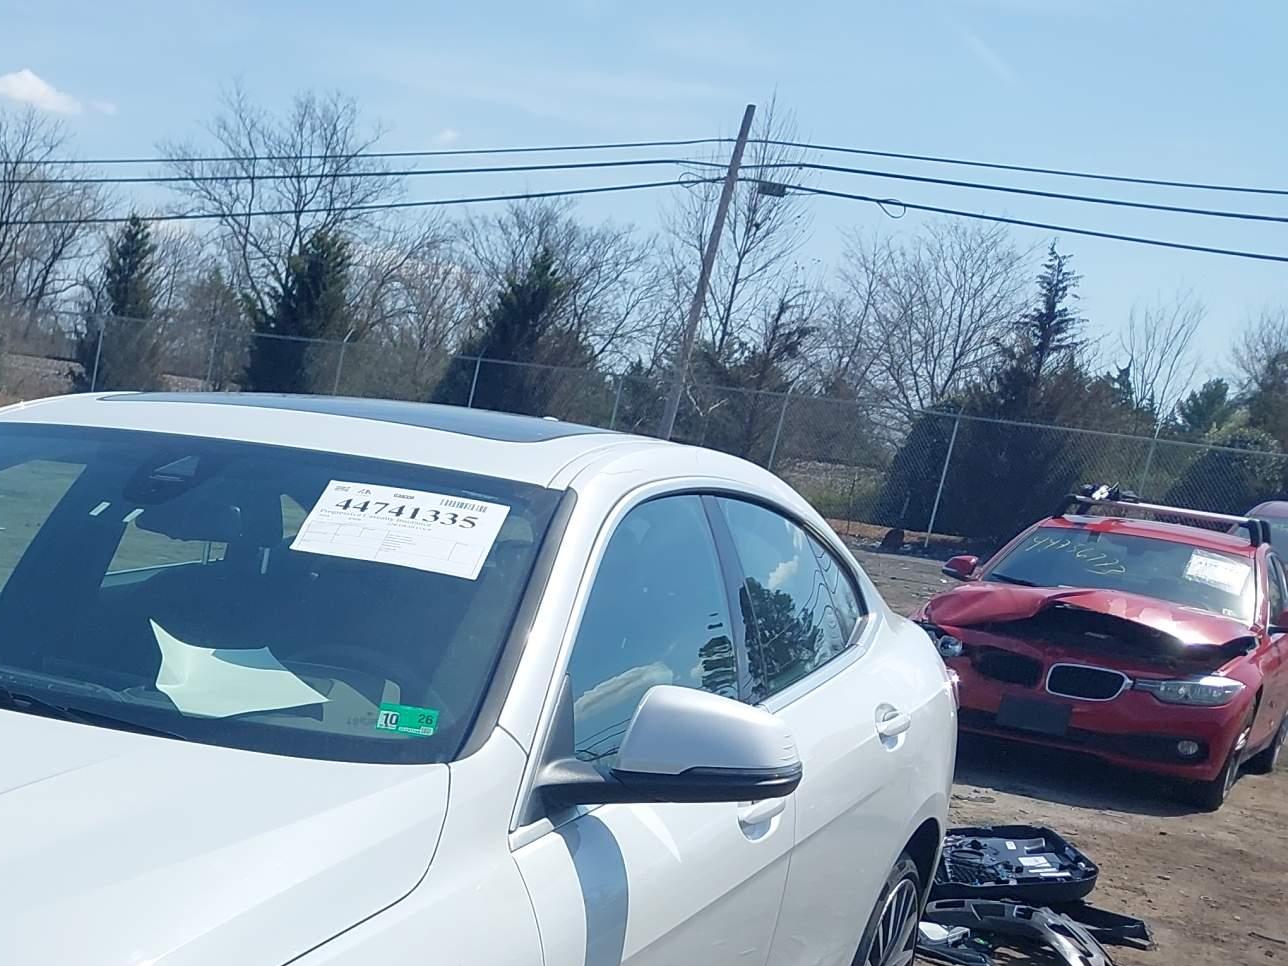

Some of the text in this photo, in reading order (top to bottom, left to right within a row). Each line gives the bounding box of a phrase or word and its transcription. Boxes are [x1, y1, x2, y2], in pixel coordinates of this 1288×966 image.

[335, 498, 479, 529] 44741335
[383, 712, 434, 726] 10 26
